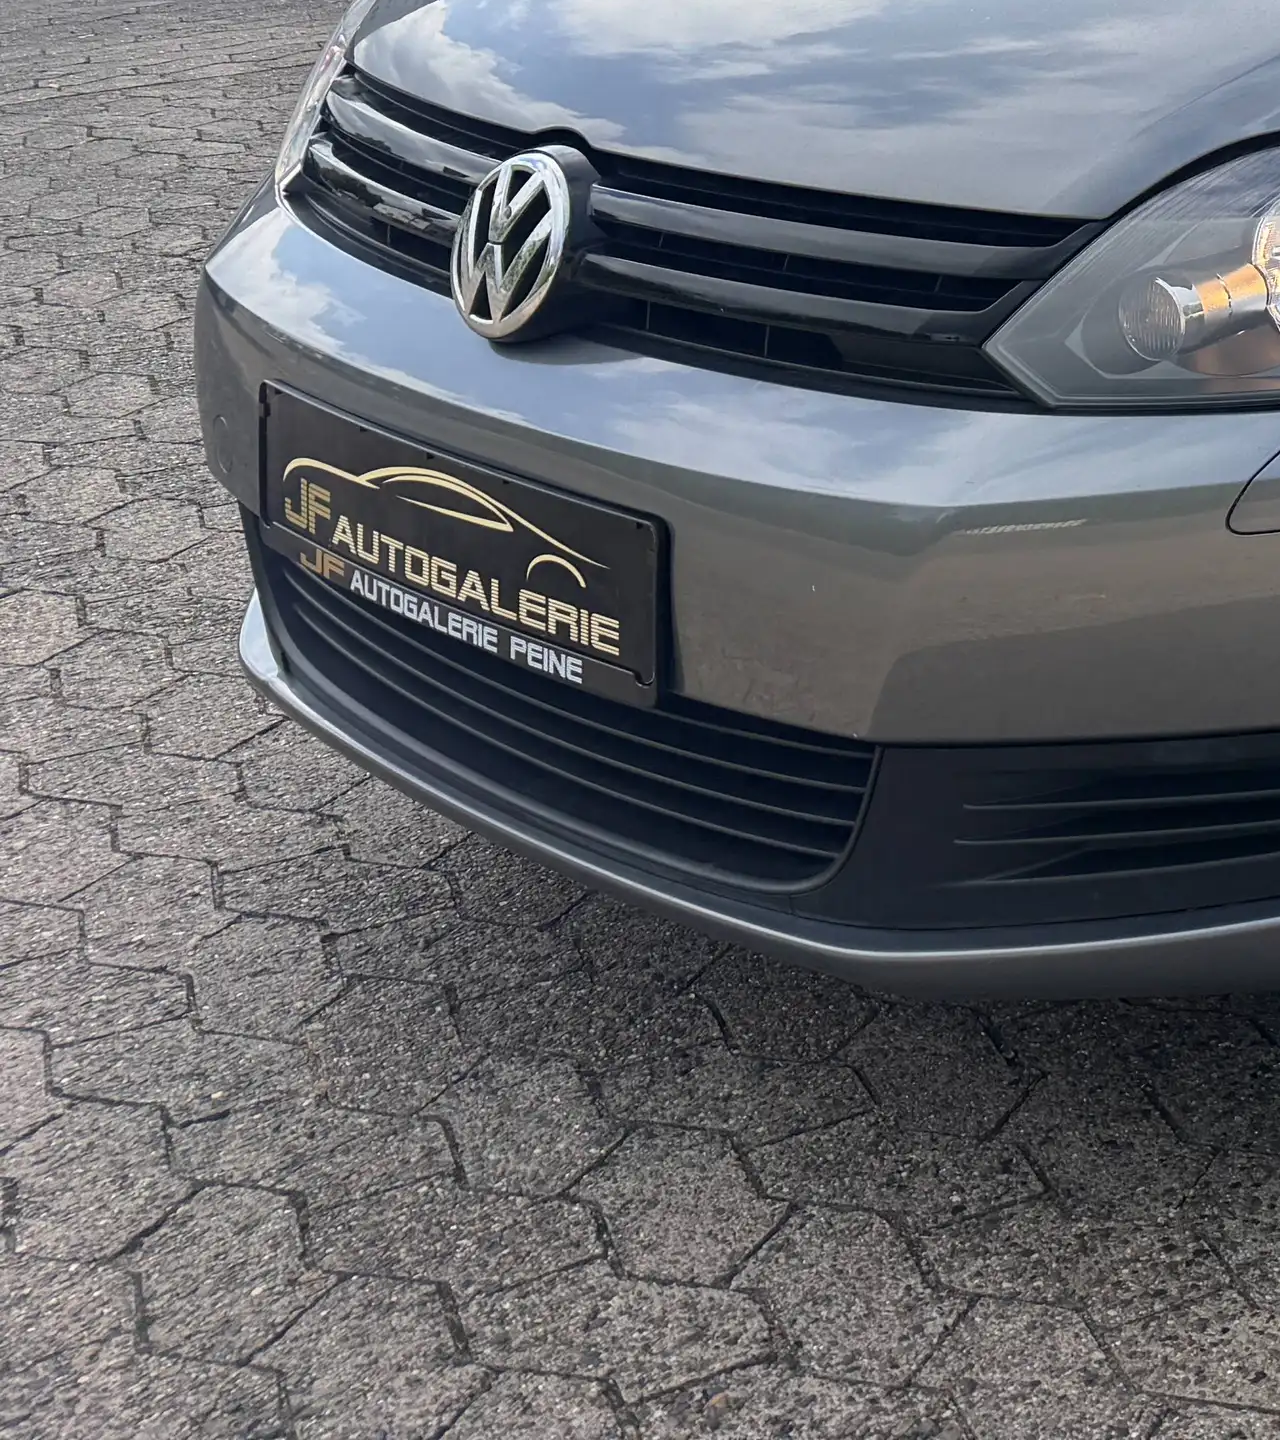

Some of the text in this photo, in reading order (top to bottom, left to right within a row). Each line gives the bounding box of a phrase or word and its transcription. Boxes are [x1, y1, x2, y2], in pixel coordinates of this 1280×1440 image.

[284, 478, 620, 656] JF AUTOGALERIE
[350, 569, 499, 654] AUTOGALERIE
[509, 635, 583, 685] PEINE
